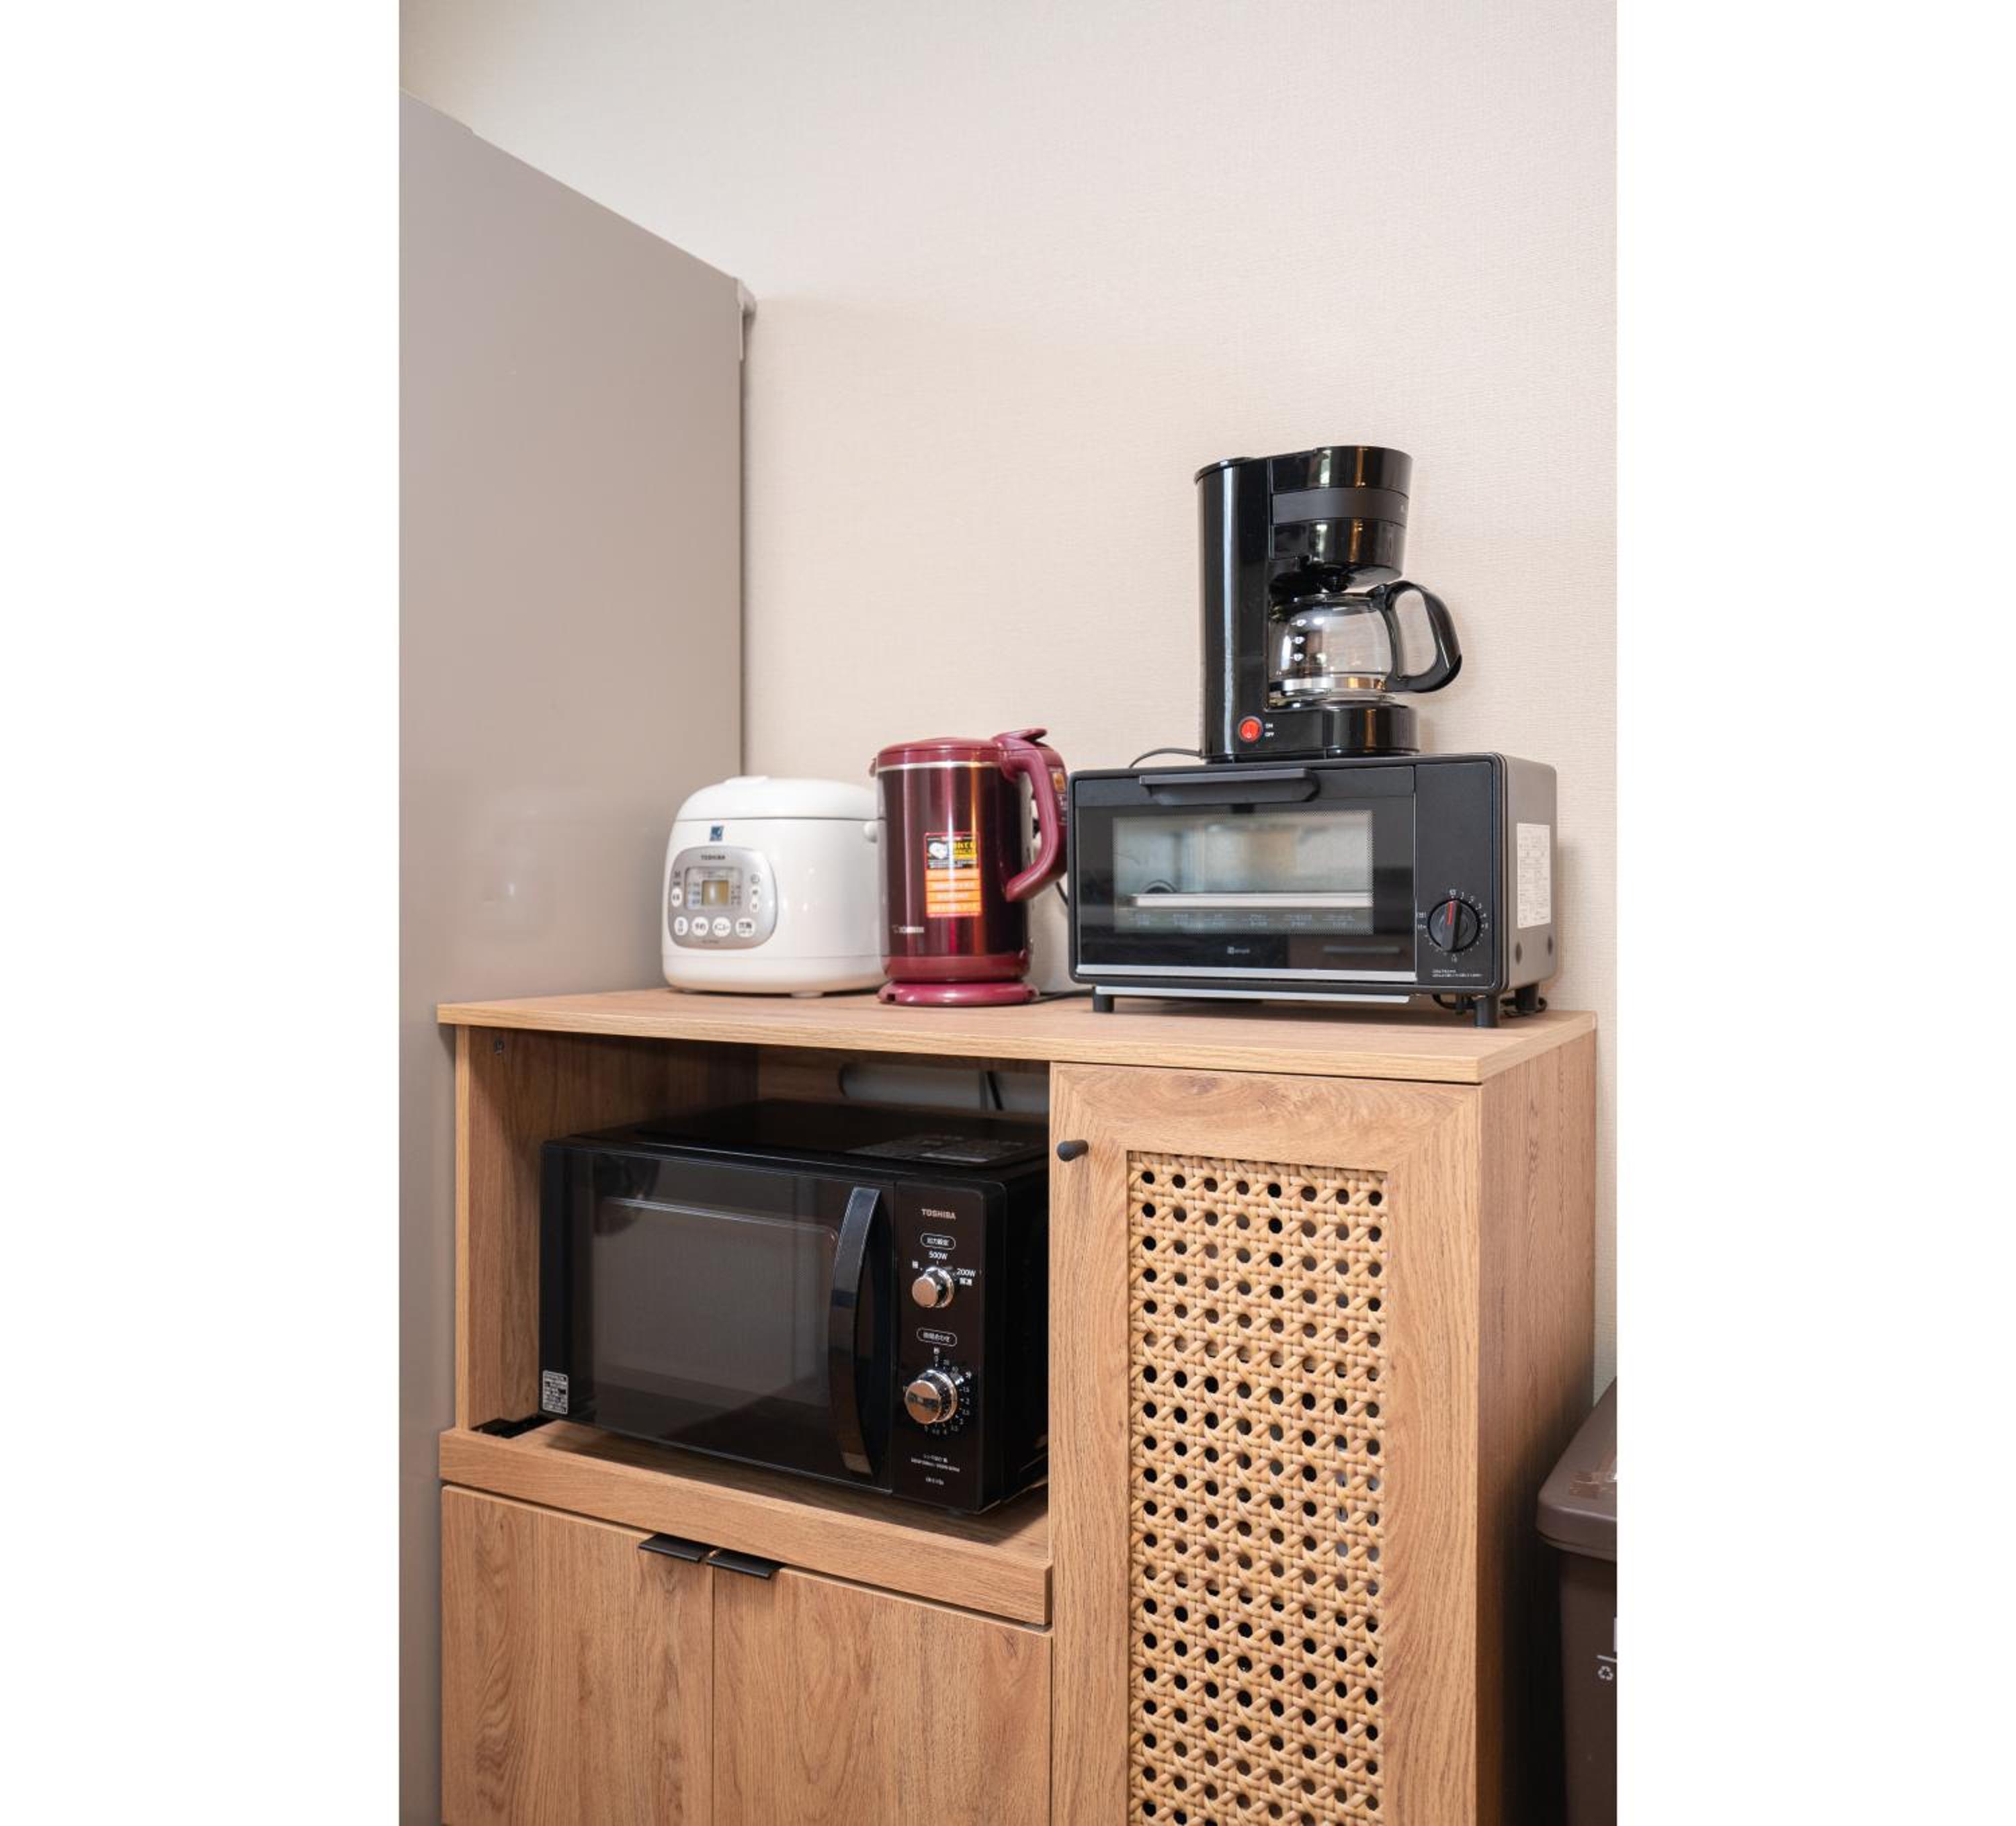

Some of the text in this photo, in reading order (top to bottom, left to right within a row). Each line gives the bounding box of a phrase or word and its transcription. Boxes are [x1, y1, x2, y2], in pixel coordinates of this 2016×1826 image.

[921, 1209, 956, 1220] TOSHIBA
[929, 1250, 948, 1260] 500W
[956, 1268, 976, 1277] 200W
